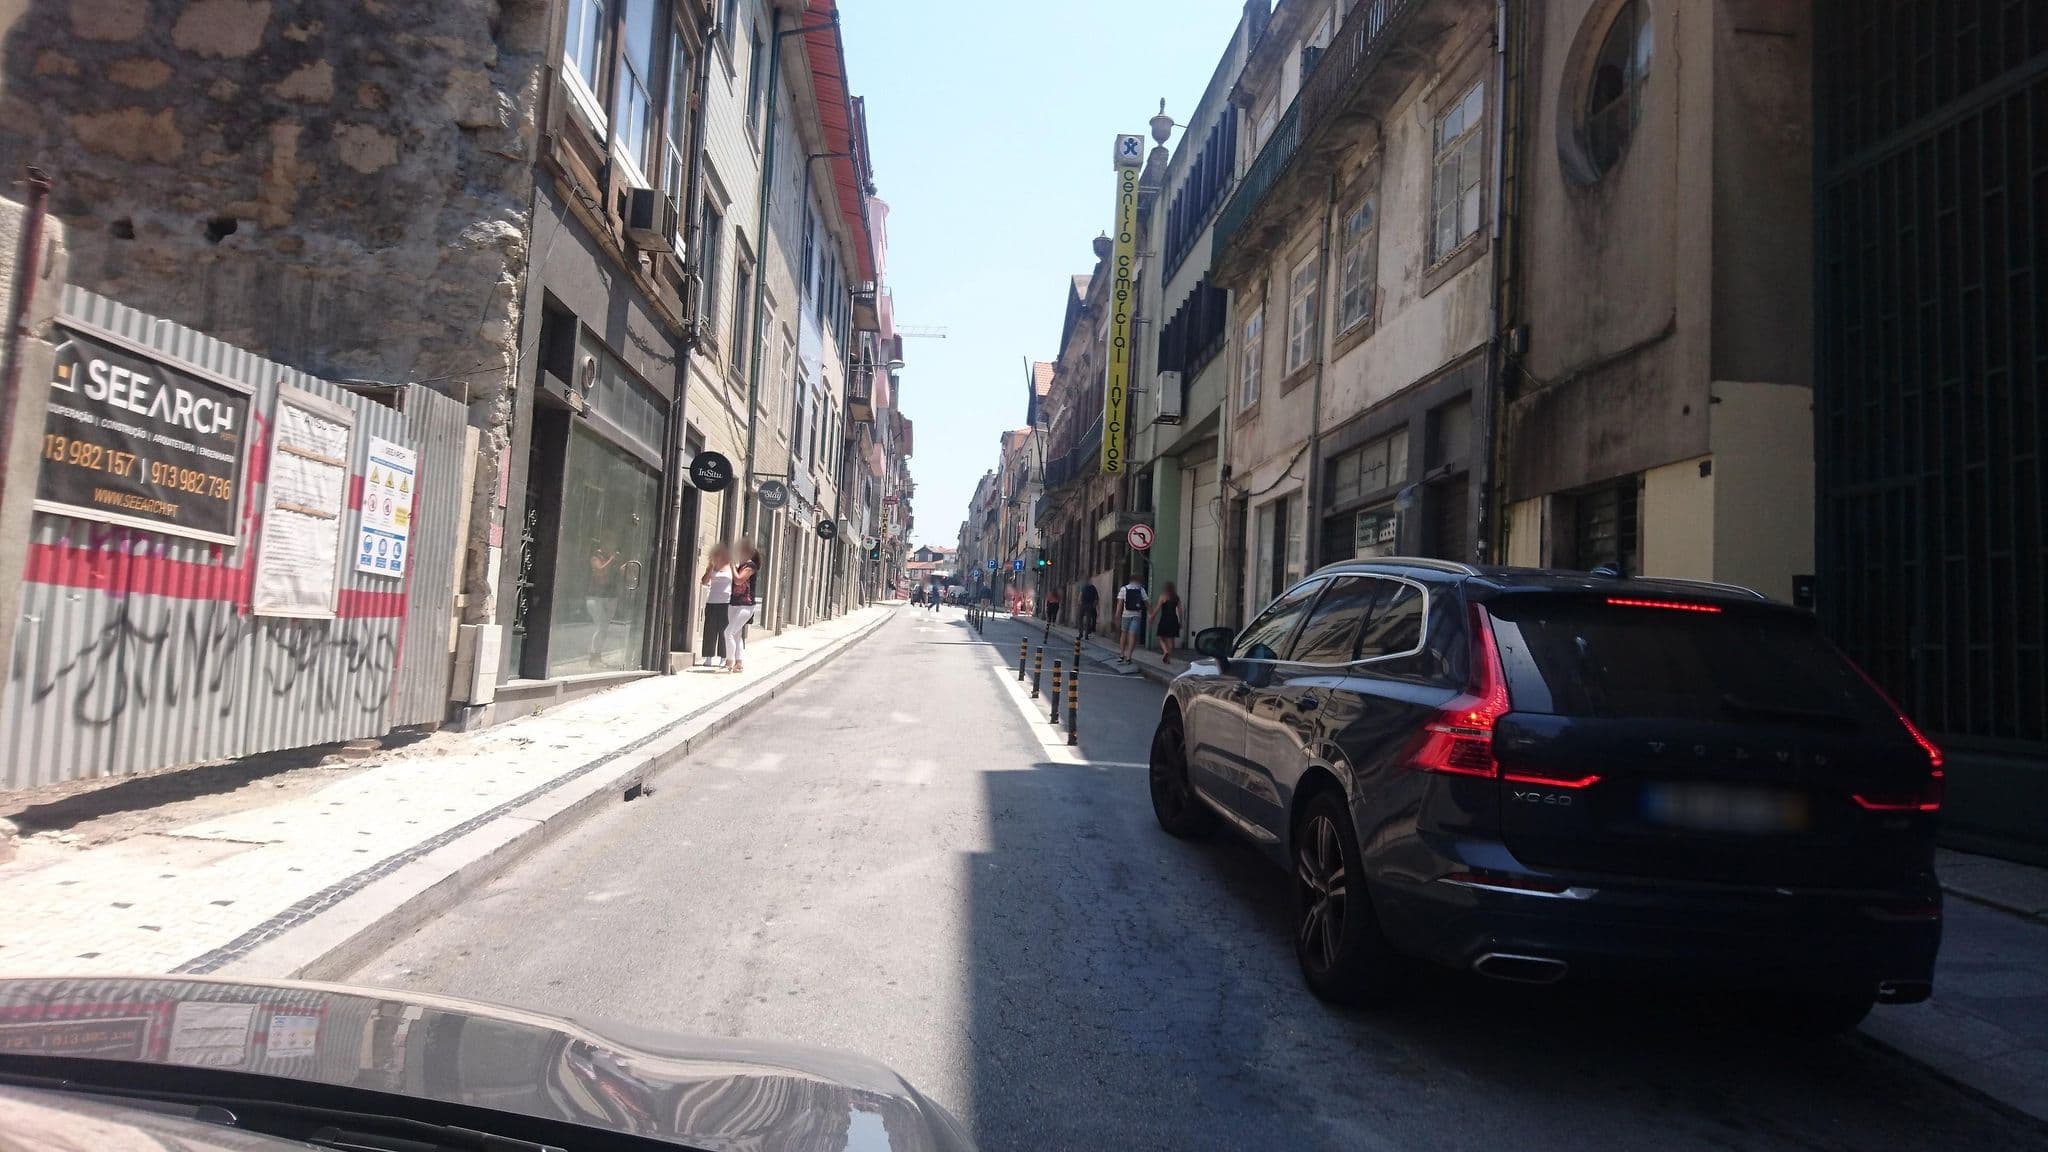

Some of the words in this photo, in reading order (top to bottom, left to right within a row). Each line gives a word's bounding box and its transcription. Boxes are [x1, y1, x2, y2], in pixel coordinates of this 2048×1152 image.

[84, 359, 233, 433] SEEARCH
[44, 434, 67, 461] 13
[69, 440, 102, 471] 982
[107, 449, 137, 478] 157
[152, 461, 177, 489] 913
[180, 468, 205, 495] 982
[208, 475, 231, 501] 736
[94, 488, 179, 517] WWW.SEEARCH.PT
[1647, 740, 1828, 767] VOLVO
[1511, 790, 1573, 806] XC60
